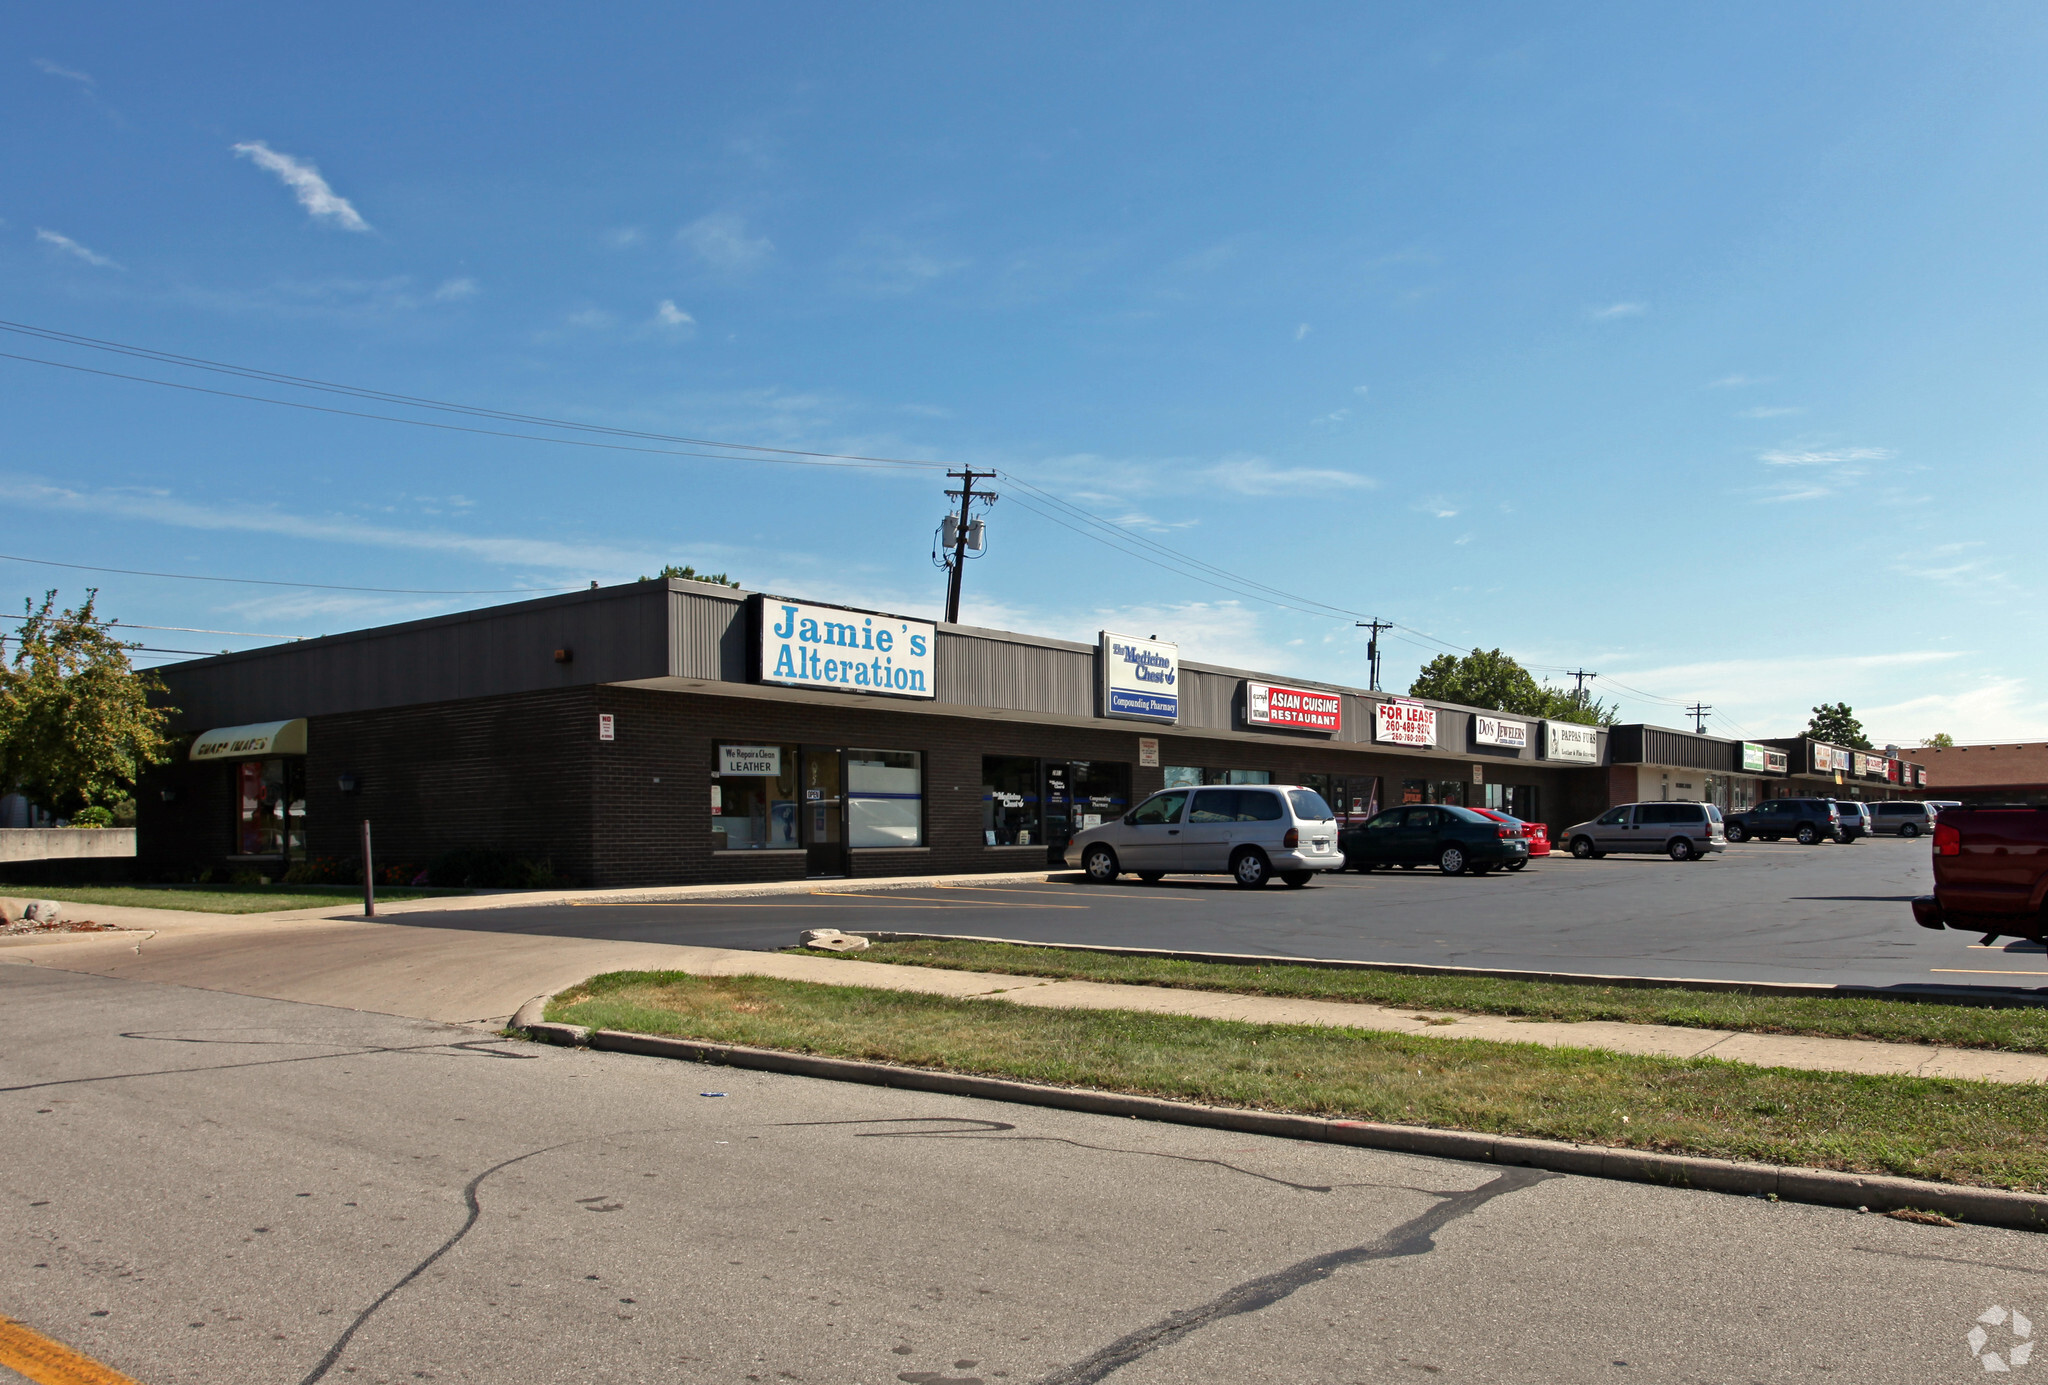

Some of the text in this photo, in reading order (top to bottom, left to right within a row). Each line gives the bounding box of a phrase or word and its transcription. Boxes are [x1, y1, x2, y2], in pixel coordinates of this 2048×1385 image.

[774, 605, 927, 656] Jamie's
[1124, 646, 1169, 668] Medicine
[773, 644, 926, 691] Alteration
[1135, 664, 1164, 683] Chest
[1113, 695, 1175, 713] Compounding Pharmacy
[1271, 692, 1300, 709] ASIAN
[1302, 696, 1338, 713] CUISINE
[1271, 709, 1336, 725] RESTAURANT
[1380, 705, 1434, 724] FOR LEASE
[1561, 729, 1596, 744] PAPPAS FURS
[726, 749, 736, 758] We
[737, 750, 755, 760] Repair
[759, 750, 775, 759] Clean
[730, 762, 771, 772] LEATHER
[808, 791, 819, 799] OPEN
